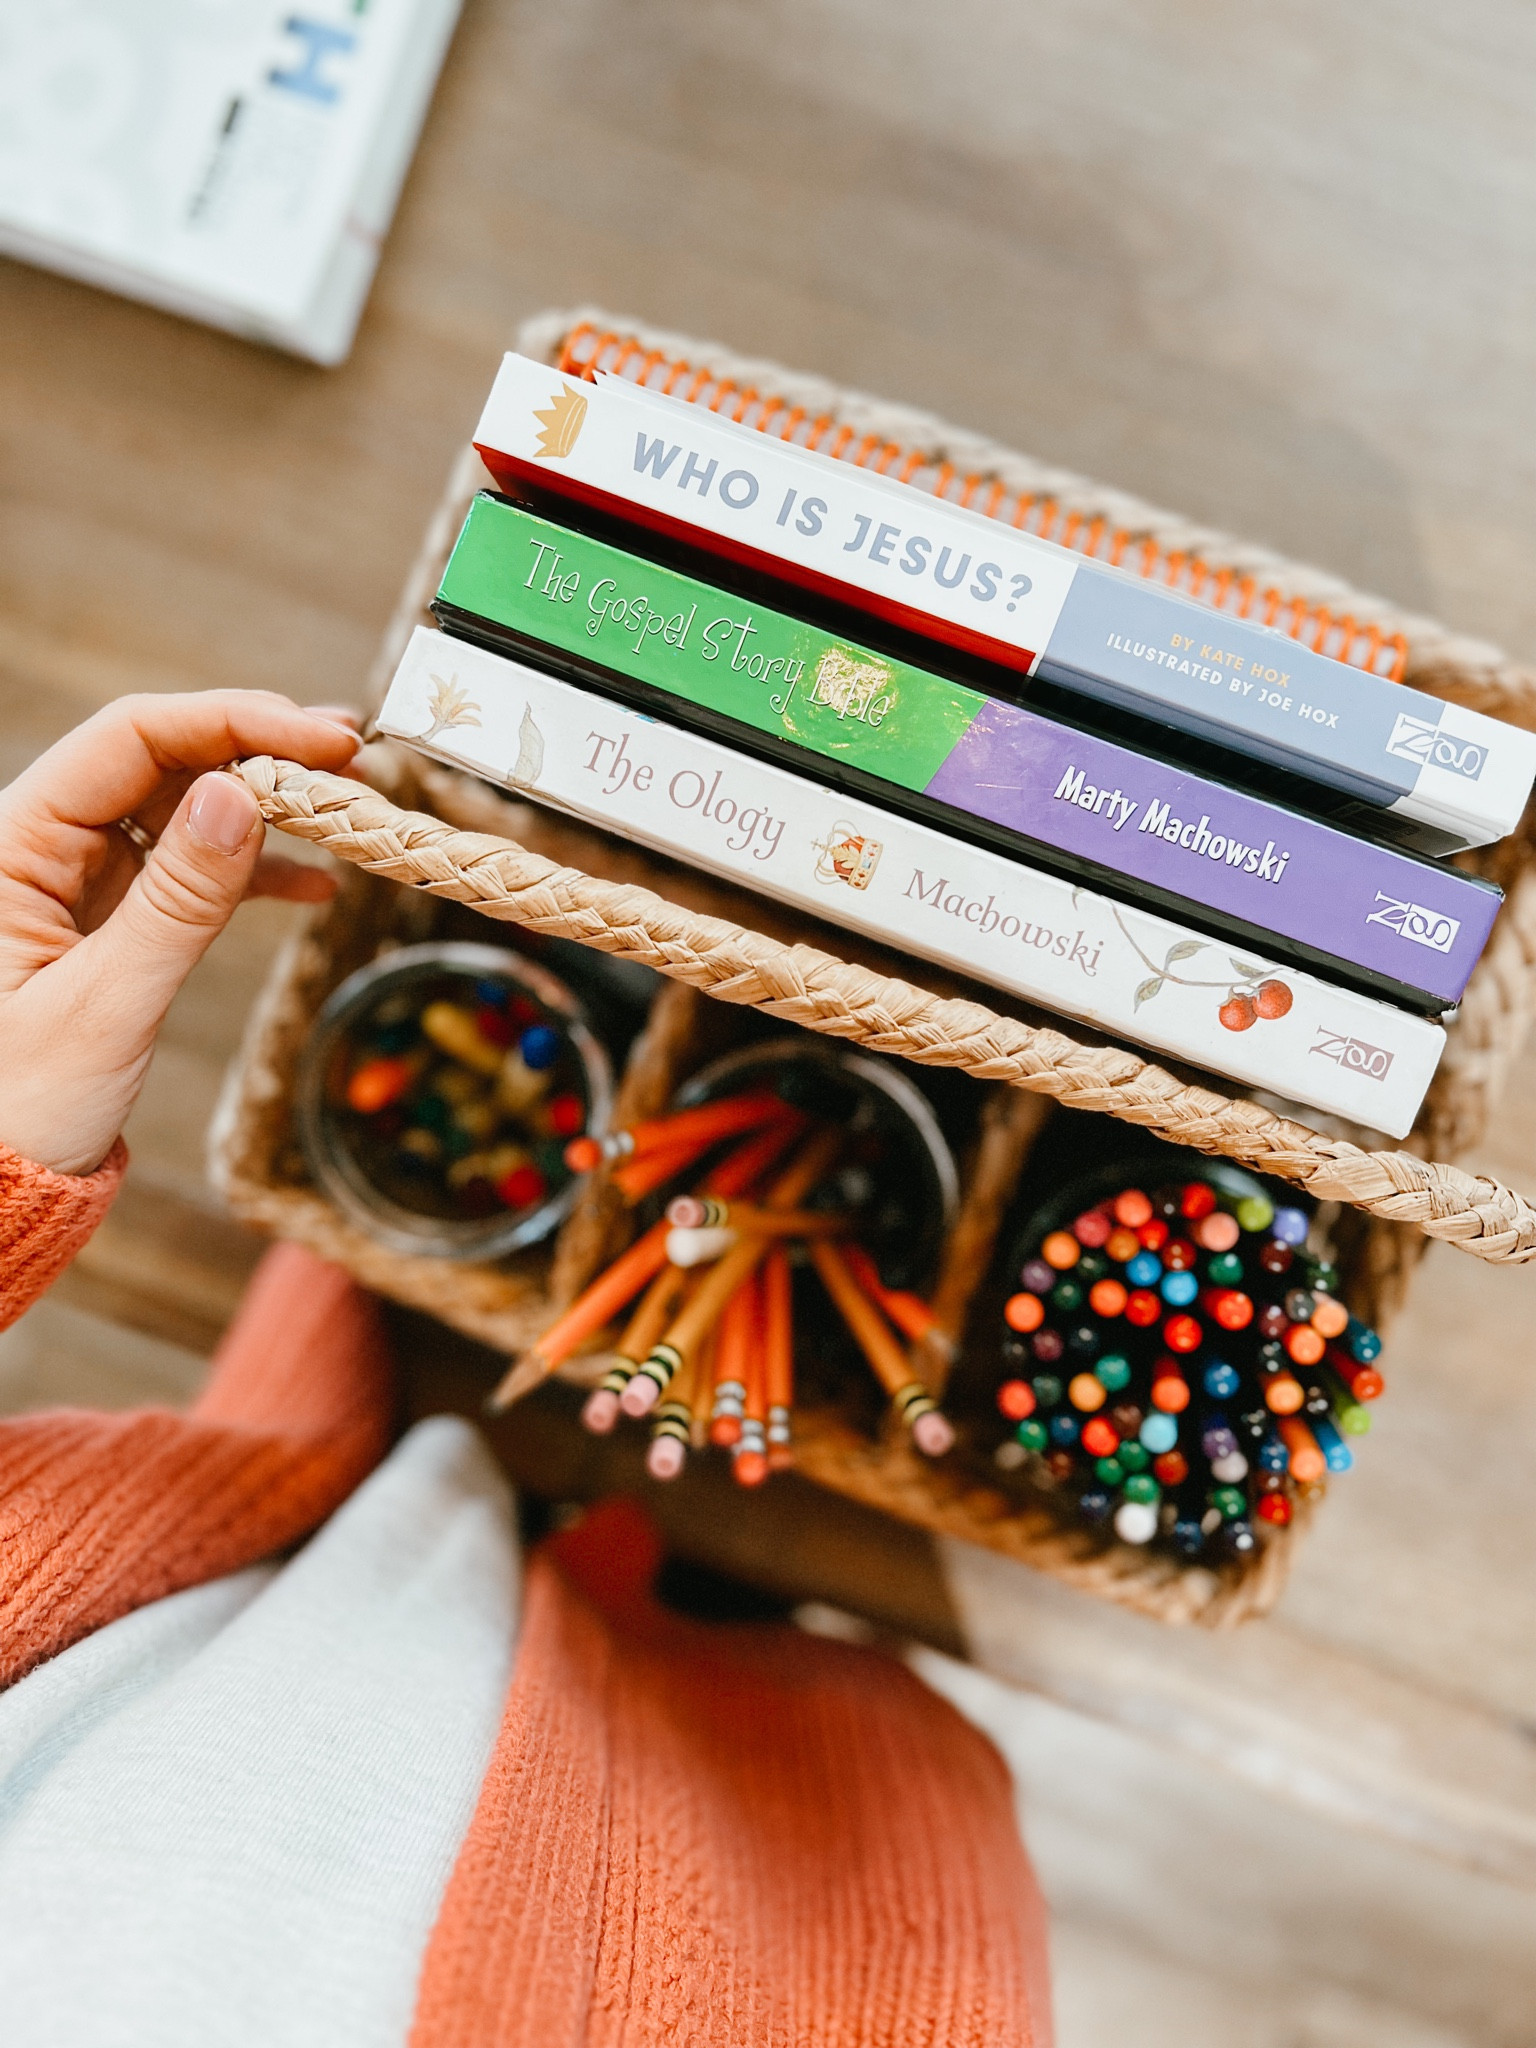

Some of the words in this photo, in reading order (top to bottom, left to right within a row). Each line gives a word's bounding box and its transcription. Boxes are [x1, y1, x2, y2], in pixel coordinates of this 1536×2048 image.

[633, 432, 759, 509] WHO
[776, 488, 827, 536] IS
[843, 513, 1033, 612] JESUS?
[523, 537, 581, 603] The
[586, 578, 698, 655] Gospel
[702, 615, 807, 714] Story
[806, 657, 890, 727] Bble
[1106, 633, 1223, 686] ILLUSTRATED
[1229, 678, 1255, 696] BY
[1257, 688, 1293, 712] JOE
[1298, 703, 1340, 729] HOX
[1170, 633, 1195, 652] BY
[1200, 645, 1245, 671] KATE
[1251, 663, 1291, 688] HOX
[582, 730, 654, 795] The
[668, 770, 787, 861] Ology
[1053, 765, 1139, 831] Marty
[1138, 799, 1290, 884] Machowski
[903, 868, 1105, 977] Machowski
